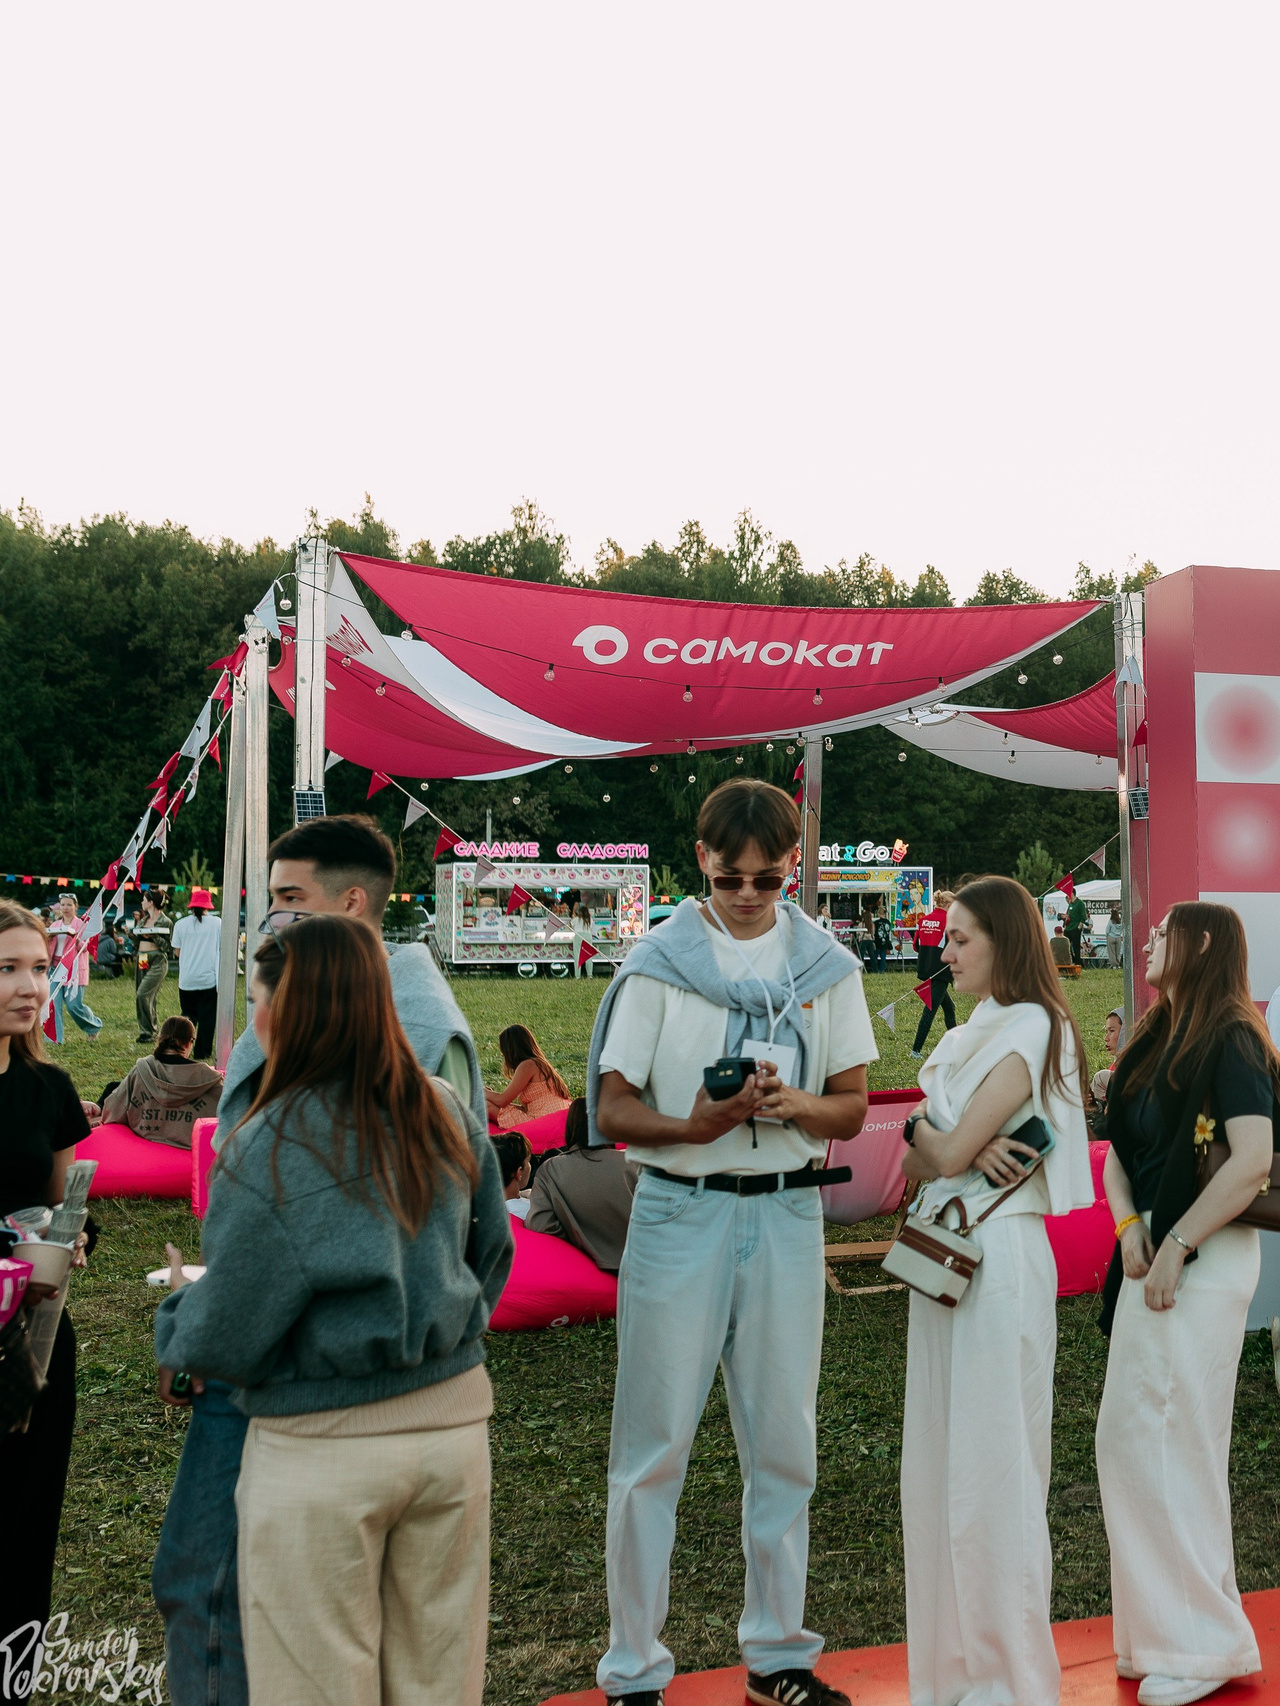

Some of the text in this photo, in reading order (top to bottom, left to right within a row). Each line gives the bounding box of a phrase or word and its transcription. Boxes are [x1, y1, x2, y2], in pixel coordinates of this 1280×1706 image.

[643, 636, 894, 668] самокат
[453, 841, 650, 859] СЛАДКИЕ СЛАДОСТИ
[818, 842, 841, 862] at
[856, 840, 891, 862] Go
[921, 919, 941, 929] Kappa
